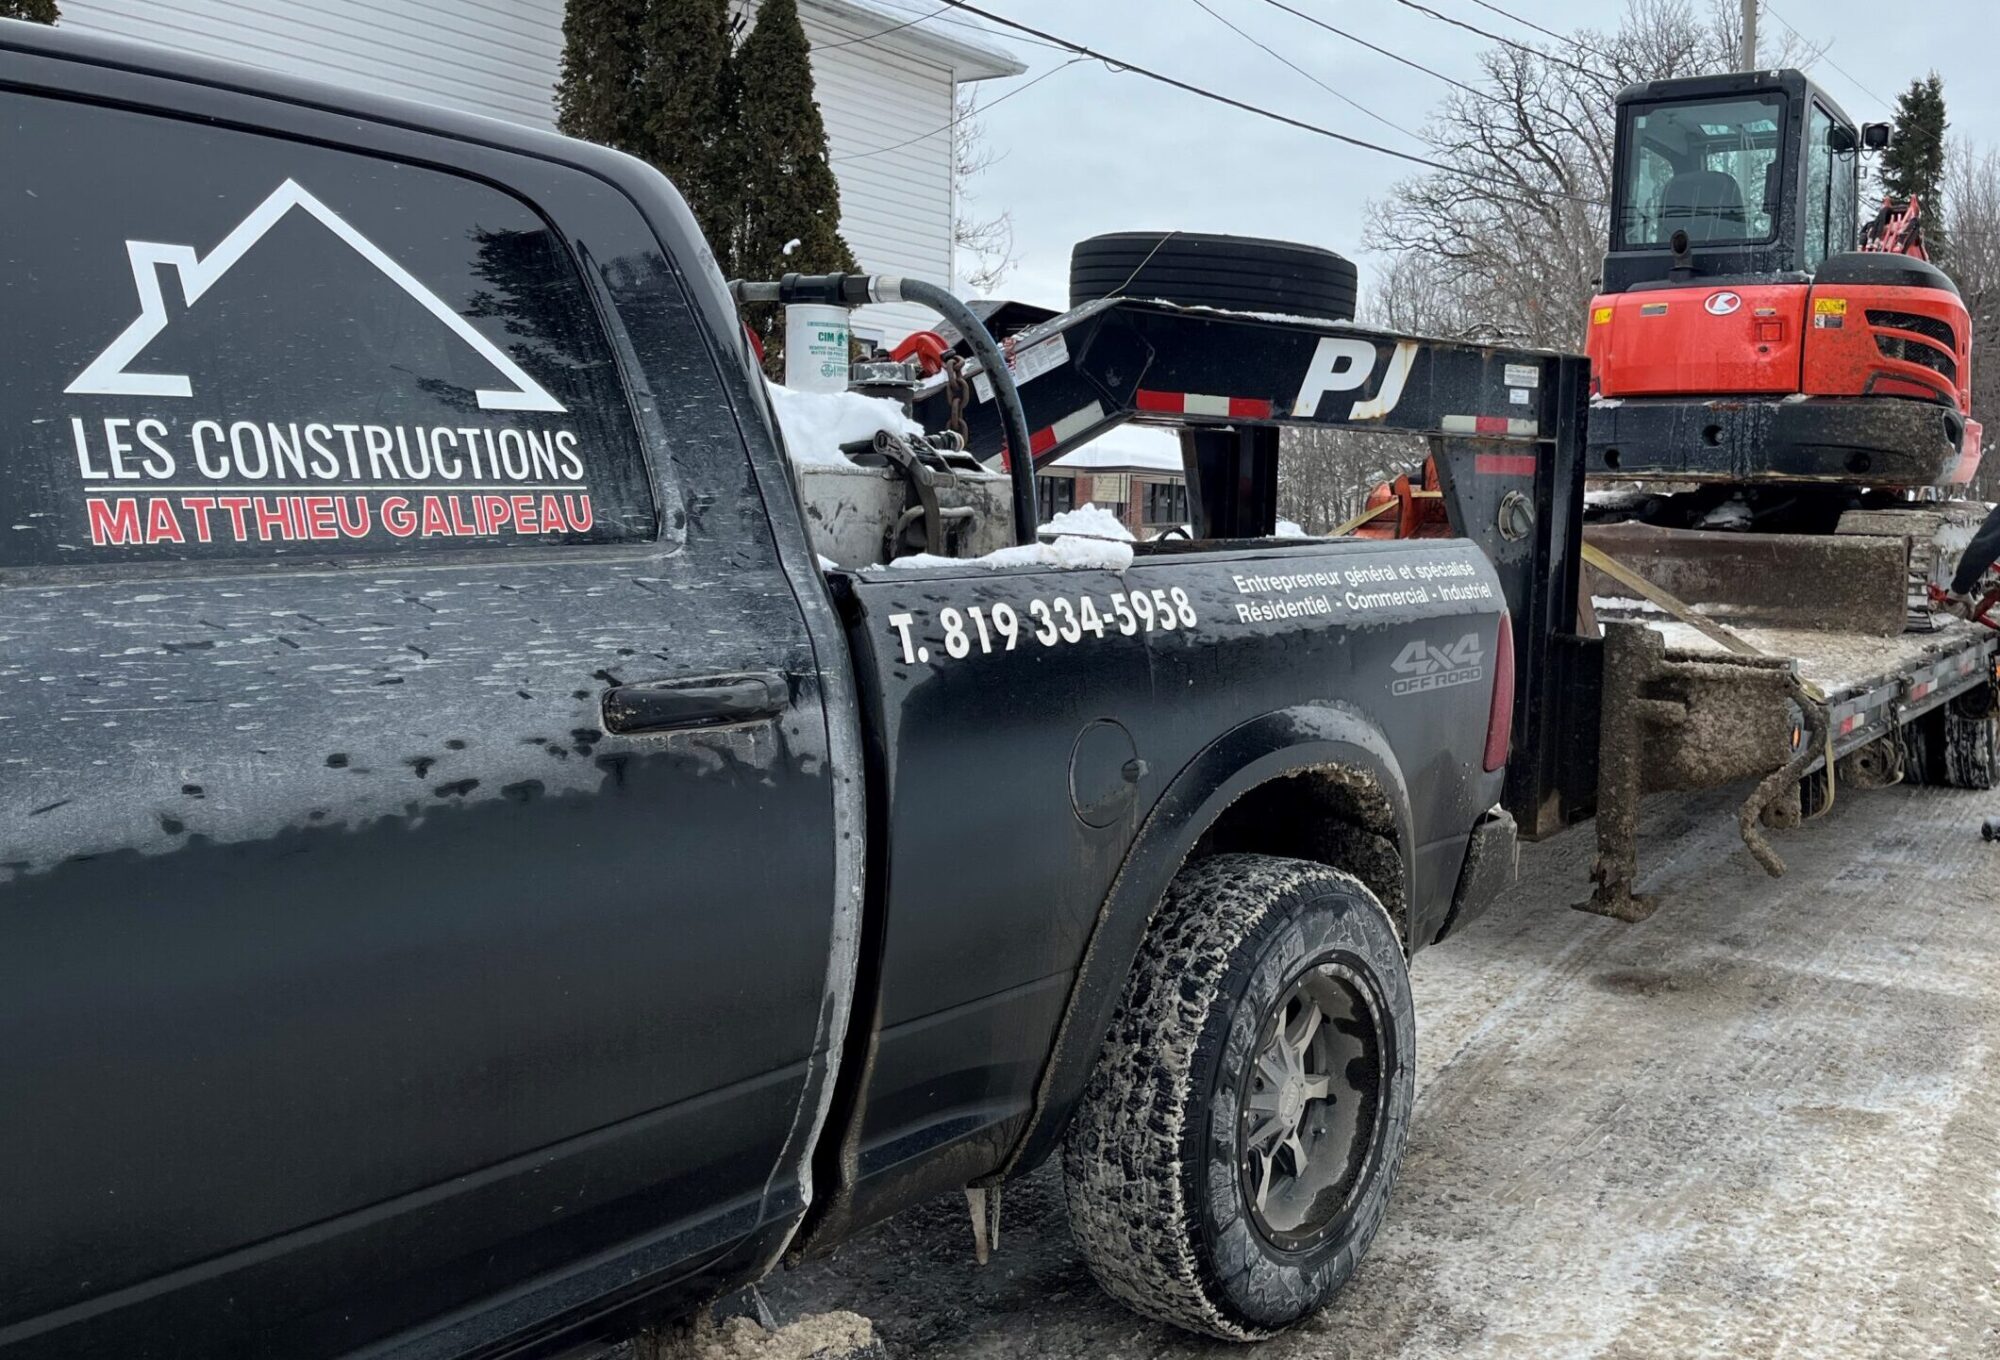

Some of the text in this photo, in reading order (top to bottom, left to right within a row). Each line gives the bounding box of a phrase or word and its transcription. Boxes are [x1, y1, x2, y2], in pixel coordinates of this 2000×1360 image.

[818, 332, 835, 342] CIM
[1291, 337, 1418, 420] PJ
[71, 418, 584, 481] LES CONSTRUCTIONS
[86, 495, 593, 546] MATTHIEU GALIPEAU
[1232, 560, 1475, 594] Entrepreneur général et spécialisé
[888, 586, 1197, 664] T. 819 334-5958
[1235, 595, 1331, 623] Résidentiel
[1345, 586, 1430, 610] Commercial
[1438, 582, 1493, 601] Industriel
[1394, 668, 1480, 694] OFF ROAD
